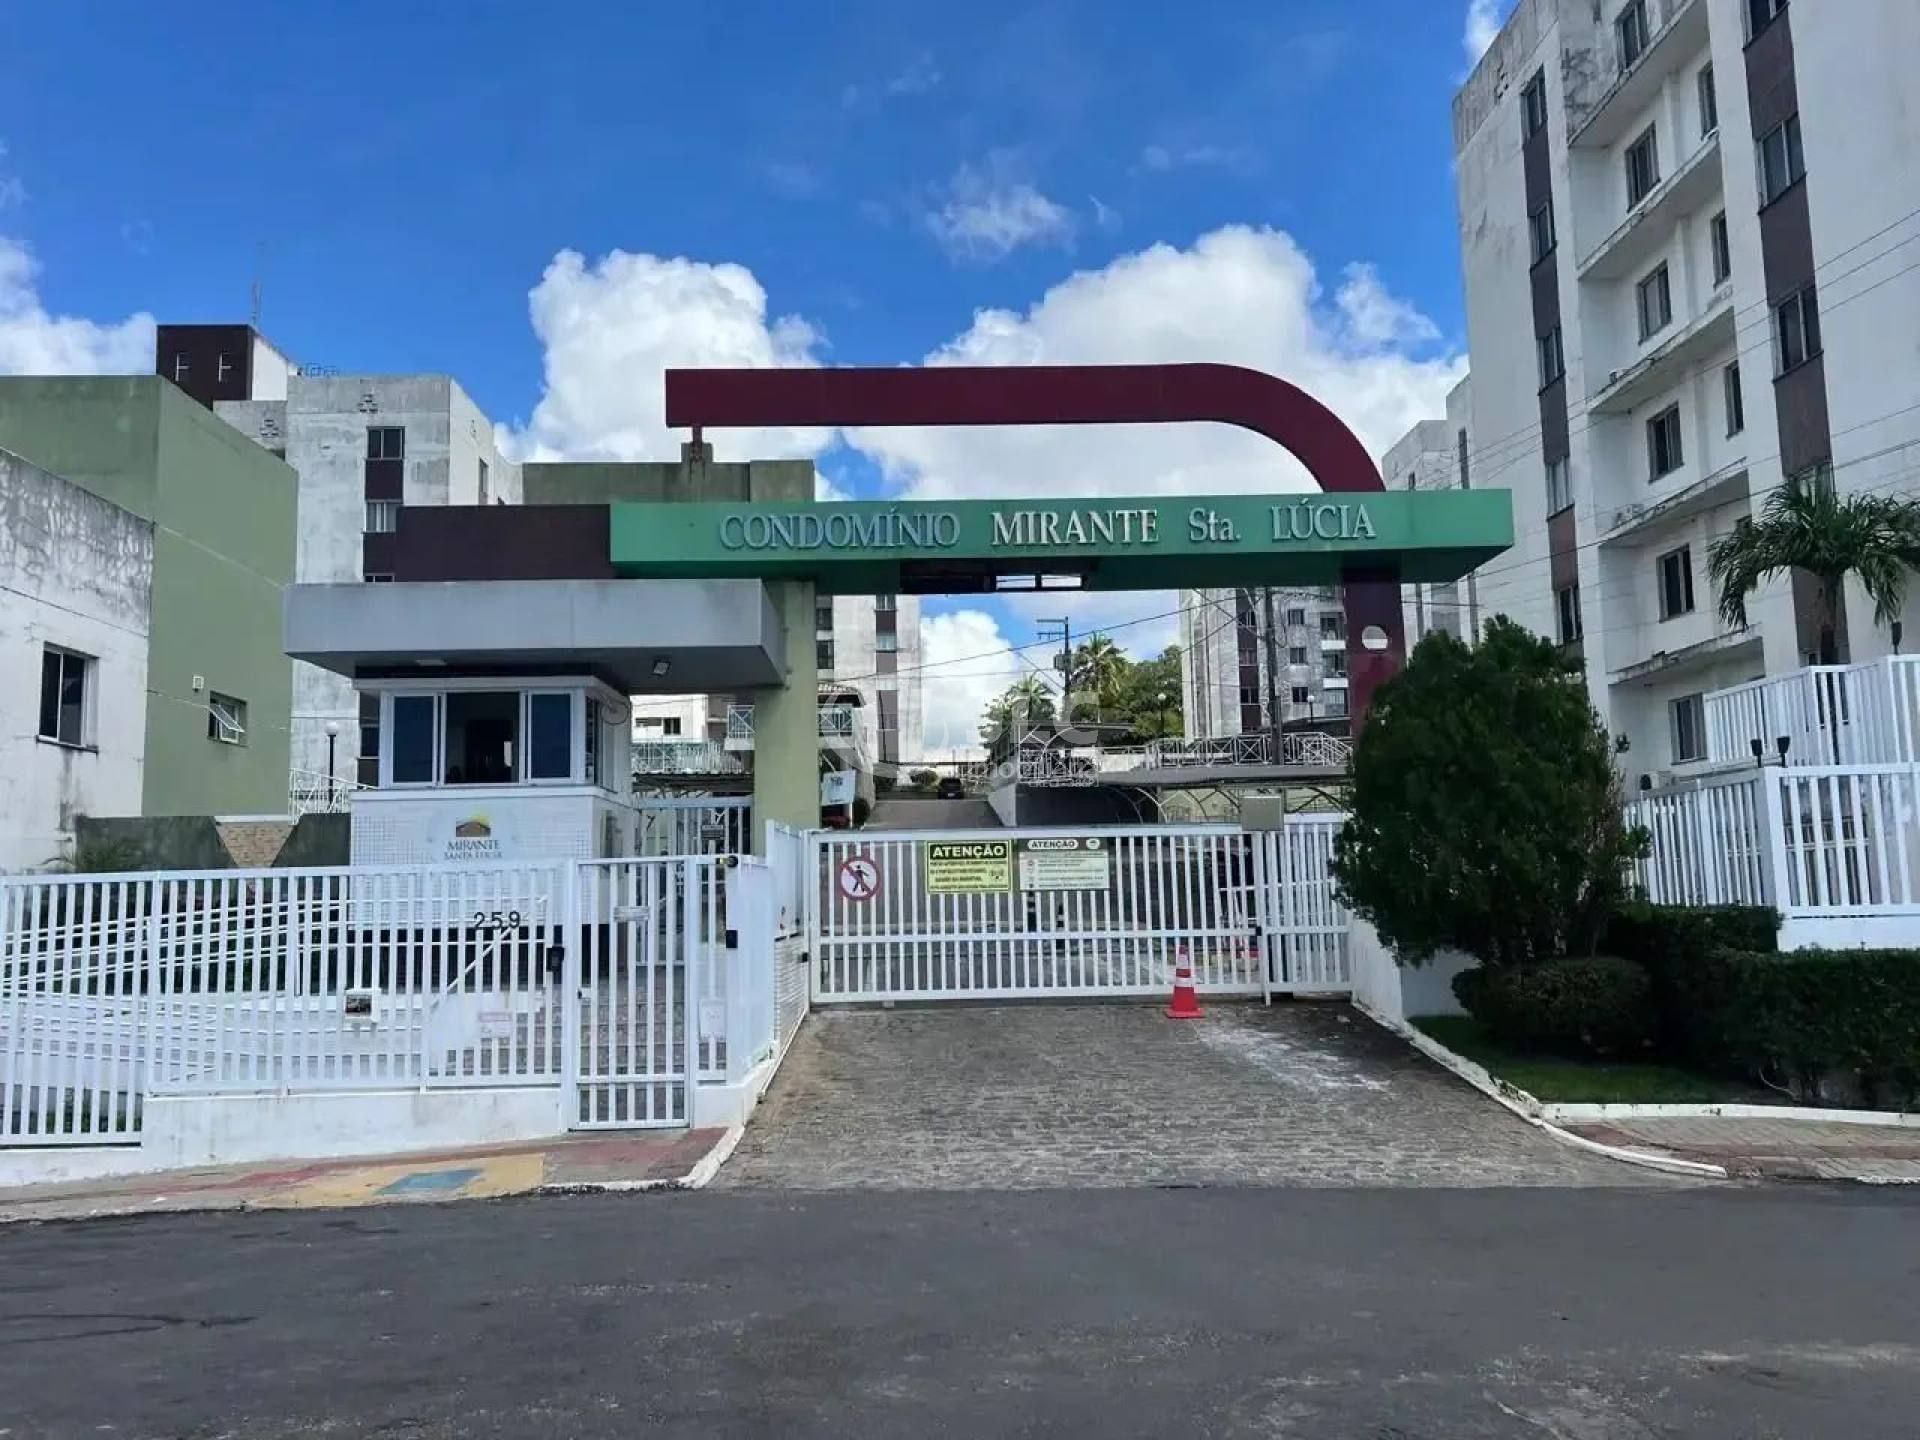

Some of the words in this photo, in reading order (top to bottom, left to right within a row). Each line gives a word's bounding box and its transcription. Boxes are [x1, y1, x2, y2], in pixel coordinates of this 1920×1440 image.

[719, 508, 961, 550] CONDOMÍNIO
[991, 509, 1160, 547] MIRANTE
[1188, 507, 1242, 543] Sta.
[1270, 498, 1377, 542] LÚCIA
[447, 839, 501, 850] MIRANTE
[932, 844, 1005, 858] ATENÇÃO
[473, 911, 520, 930] 259
